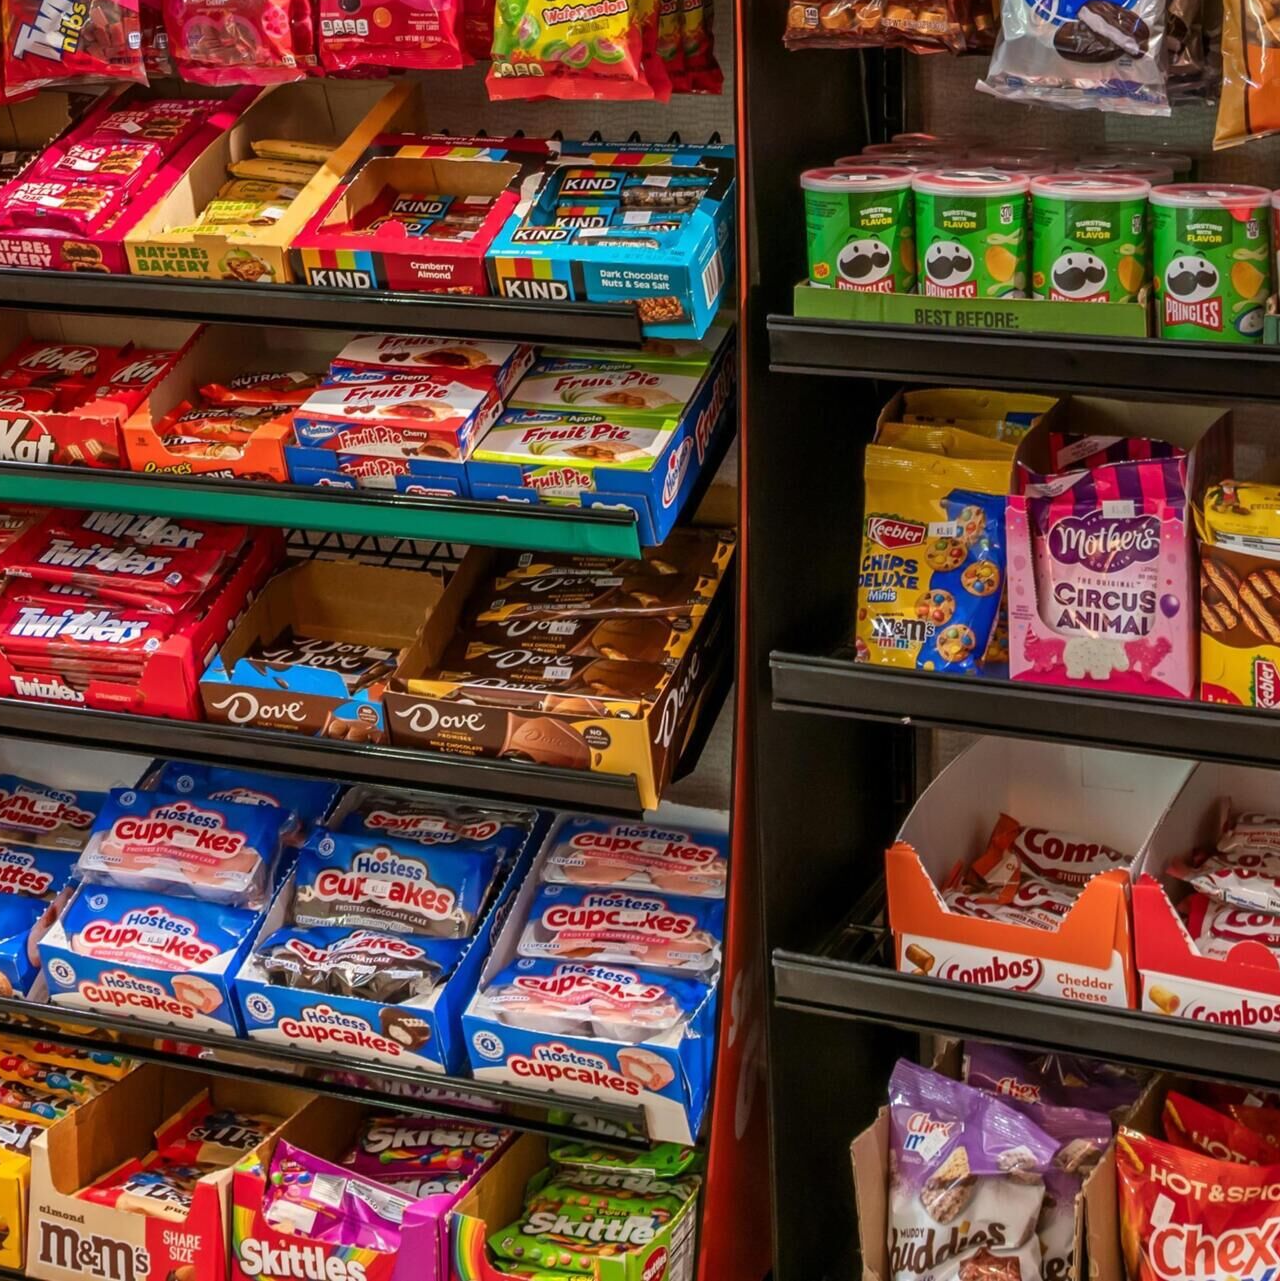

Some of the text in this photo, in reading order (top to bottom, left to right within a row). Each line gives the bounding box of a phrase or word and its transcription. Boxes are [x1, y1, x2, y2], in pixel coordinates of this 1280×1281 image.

[565, 176, 618, 192] KIND
[396, 199, 443, 215] KIND
[861, 217, 892, 227] FLAVOR
[944, 220, 976, 229] FLAVOR
[516, 230, 568, 242] KIND
[137, 259, 210, 273] BAKERY
[410, 262, 455, 275] Cranberry
[312, 269, 369, 288] KIND
[417, 270, 452, 279] Almond
[600, 270, 670, 282] Dark Chocolate
[914, 308, 1019, 328] BEST BEFORE:
[1165, 299, 1219, 327] PRINGLES
[344, 382, 449, 401] Fruit Pie
[569, 414, 602, 422] Apple
[521, 426, 630, 442] Fruit Pie
[1054, 582, 1156, 613] CIRCUS
[1057, 611, 1149, 636] ANIMAL
[1057, 973, 1114, 990] Cheddar
[83, 984, 195, 1020] Cupcakes
[1062, 987, 1107, 1003] Cheese
[281, 1021, 400, 1056] Cupcakes
[511, 1059, 640, 1095] Cupcakes
[163, 1229, 201, 1249] SHARE
[901, 1229, 924, 1238] MUDDY
[169, 1245, 194, 1263] SIZE
